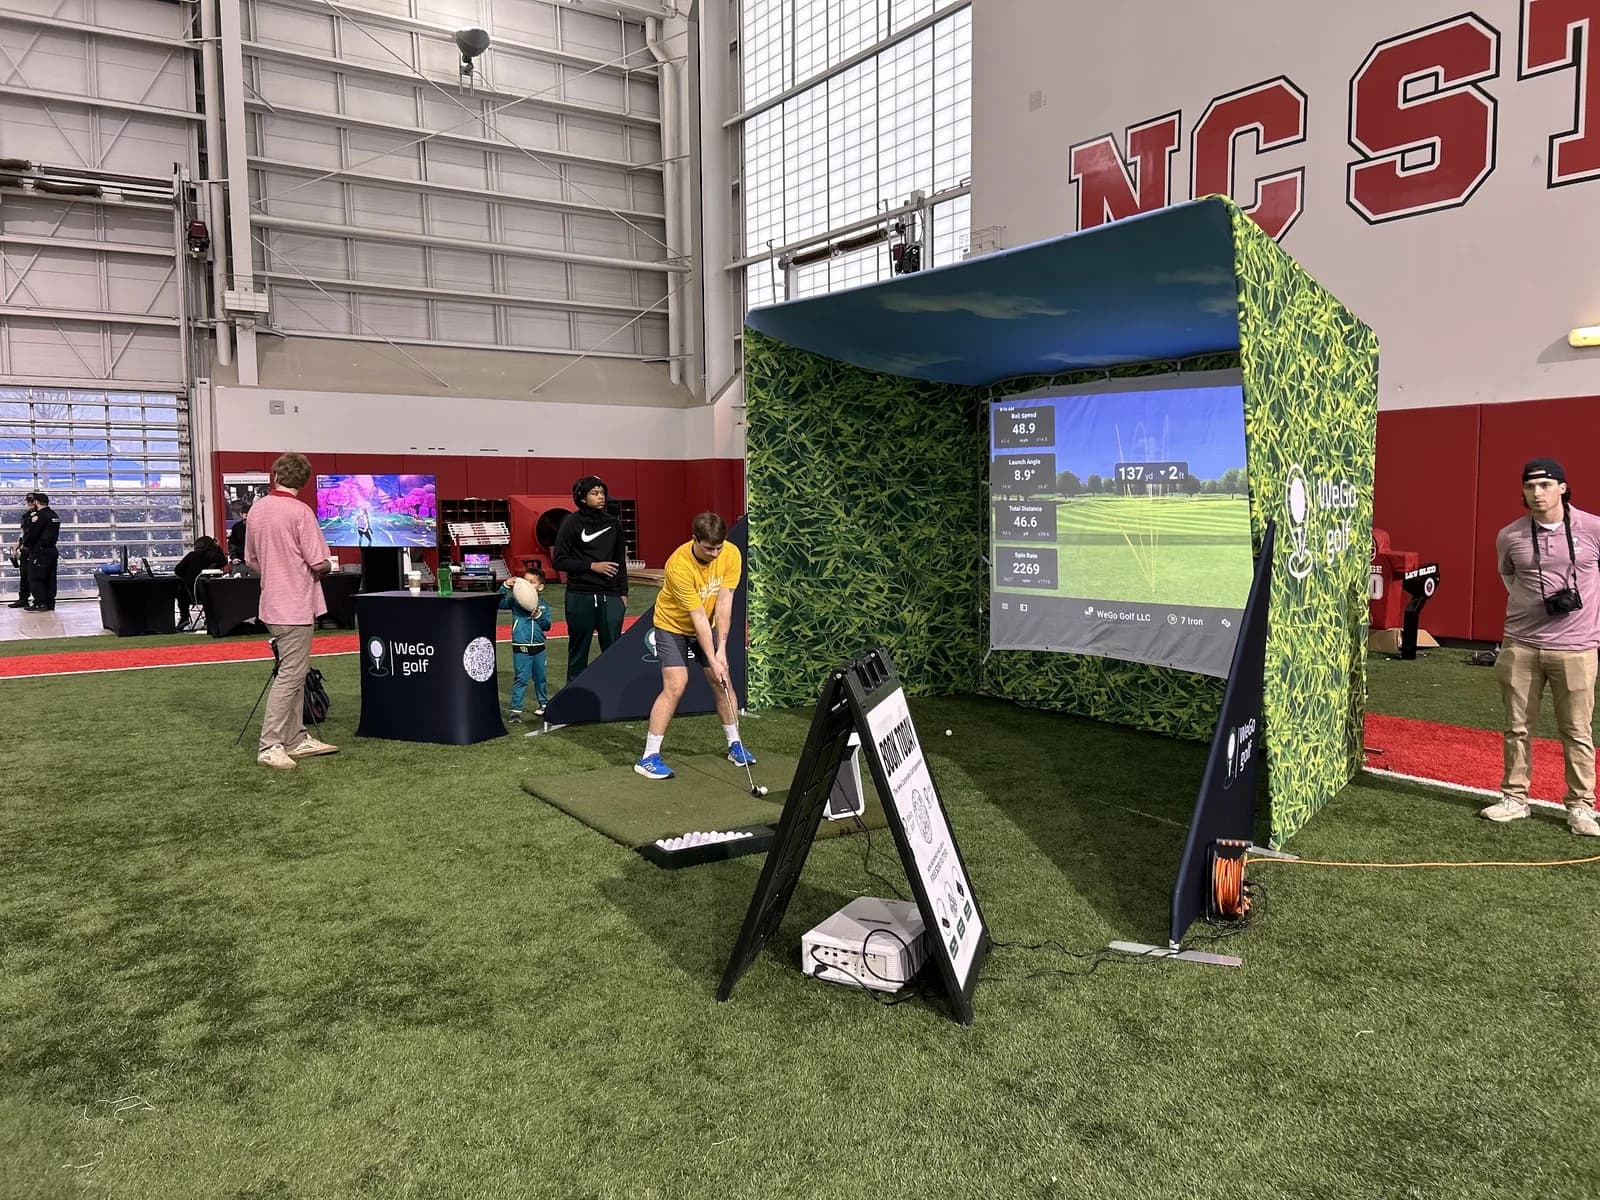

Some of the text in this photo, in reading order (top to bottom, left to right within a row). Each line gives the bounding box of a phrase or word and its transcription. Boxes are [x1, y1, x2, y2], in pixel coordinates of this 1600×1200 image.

[1069, 75, 1308, 246] NC
[1021, 411, 1037, 420] Speed
[1012, 423, 1036, 435] 48.9
[1027, 459, 1041, 467] Angle
[1014, 469, 1036, 481] 8.9°
[1119, 466, 1144, 481] 137
[1168, 465, 1179, 480] 2
[1317, 479, 1357, 510] WeGo
[1013, 516, 1038, 528] 46.6
[1326, 518, 1352, 564] golf
[1012, 562, 1040, 575] 2269
[1096, 610, 1151, 622] WeGo Golf LLC
[1180, 616, 1204, 626] 7 Iron
[394, 642, 435, 657] WeGo
[402, 659, 430, 676] golf
[1238, 718, 1256, 744] WeGo
[879, 730, 903, 779] BOOK
[893, 715, 917, 761] TODAY
[1240, 739, 1253, 772] golf
